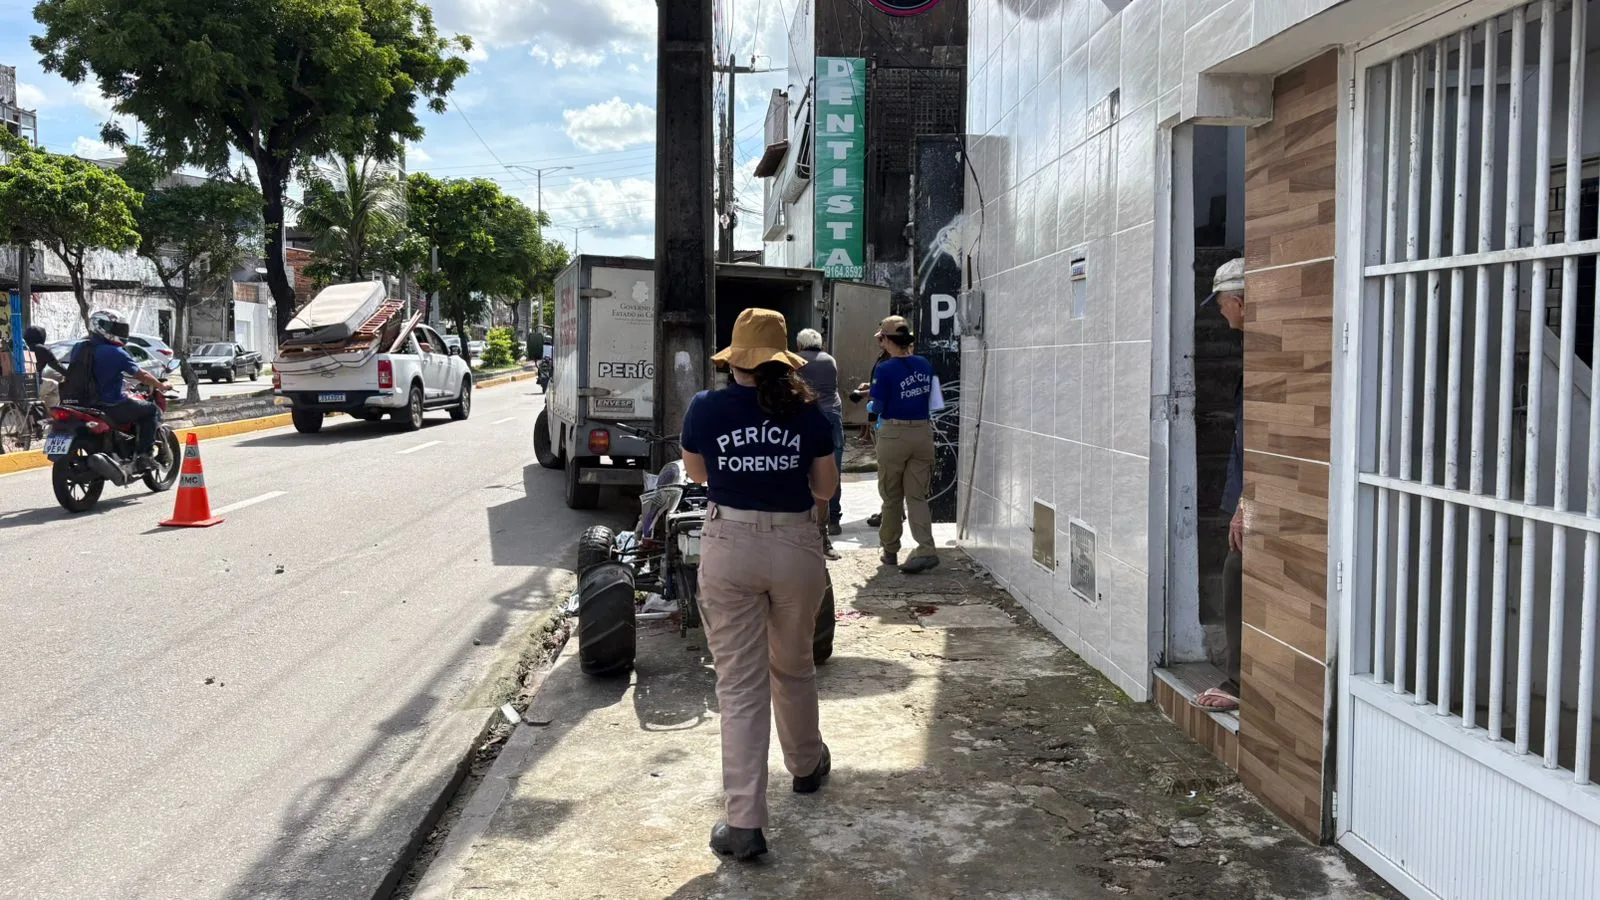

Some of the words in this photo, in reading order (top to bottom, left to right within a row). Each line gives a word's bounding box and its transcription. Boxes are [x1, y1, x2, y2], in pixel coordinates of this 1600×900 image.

[825, 59, 855, 266] DENTISTA
[900, 371, 931, 391] PERÍCIA
[716, 419, 801, 453] PERÍCIA
[717, 454, 801, 472] FORENSE
